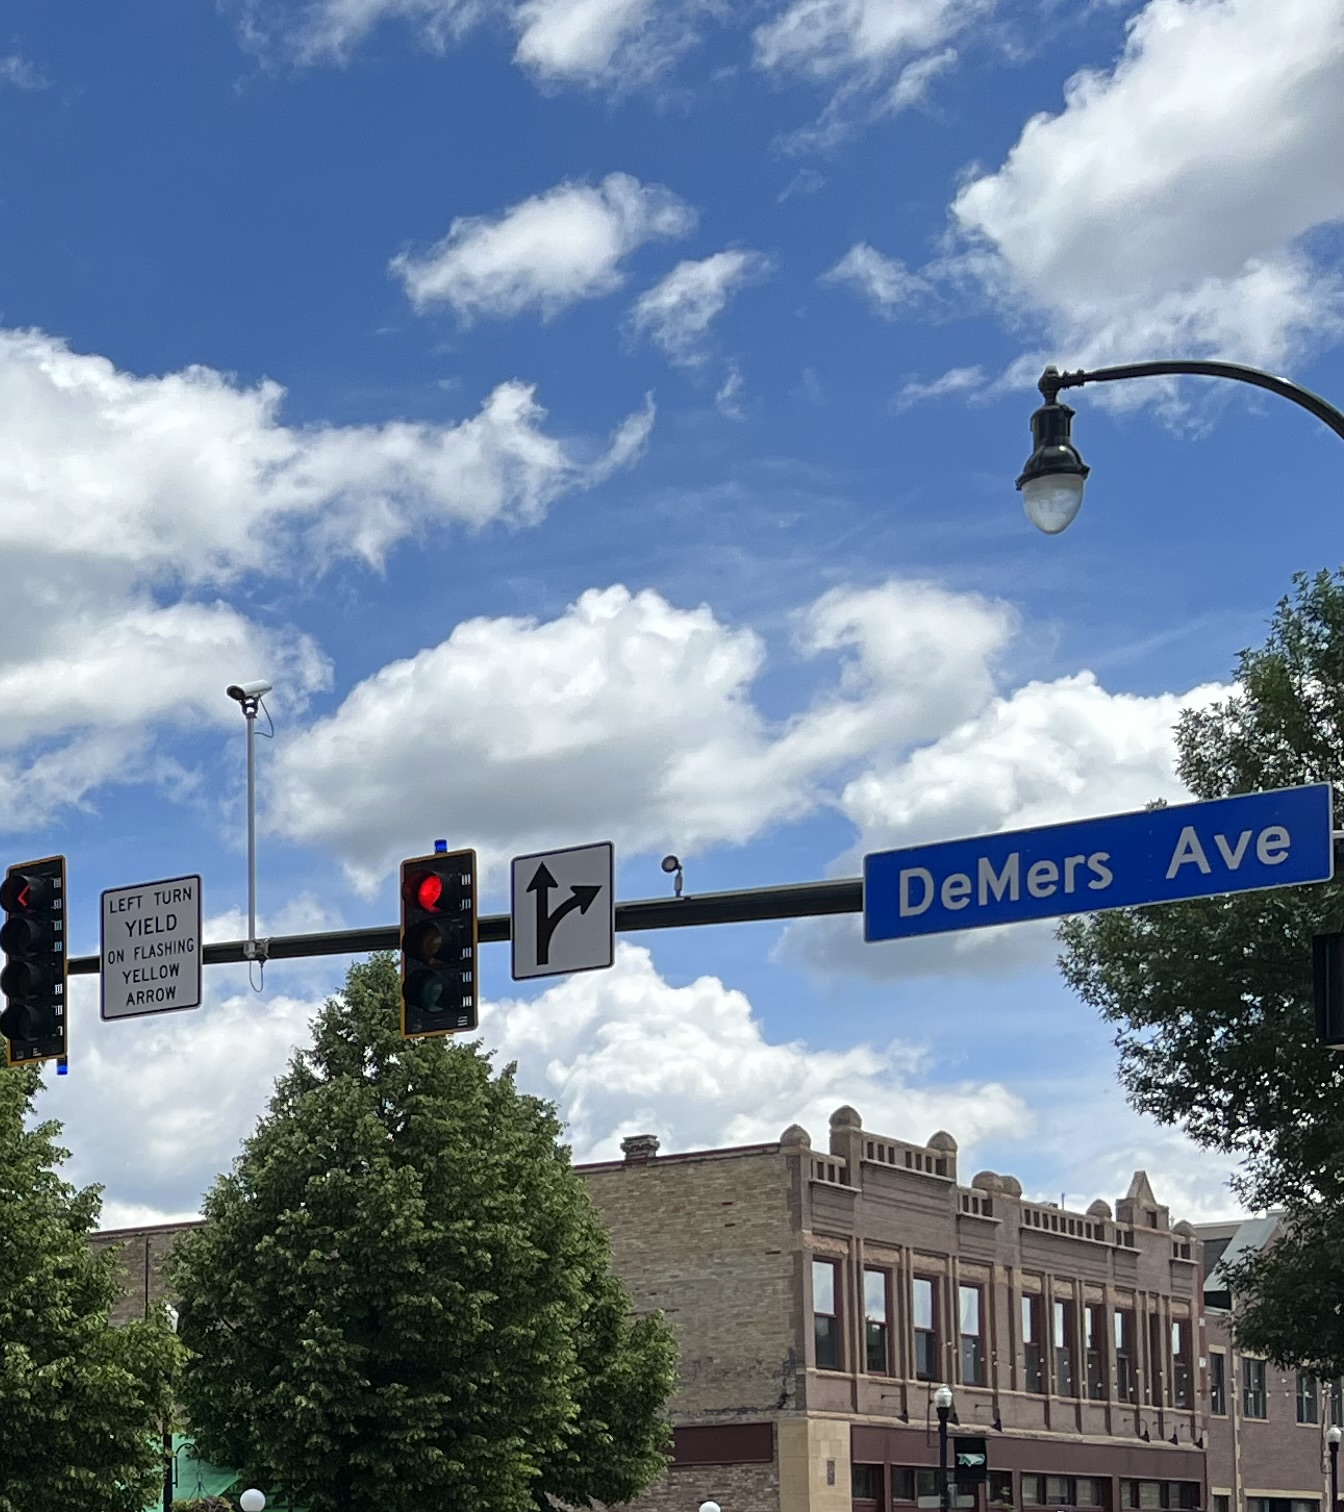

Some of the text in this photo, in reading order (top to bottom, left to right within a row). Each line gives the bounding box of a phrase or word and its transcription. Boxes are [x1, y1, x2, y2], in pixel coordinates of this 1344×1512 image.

[898, 824, 1291, 918] DeMers Ave
[109, 886, 192, 914] LEFT TURN
[125, 914, 178, 938] YIELD
[107, 938, 195, 965] ON FLASHING
[122, 962, 180, 985] YELLOW
[126, 986, 177, 1007] ARROW
